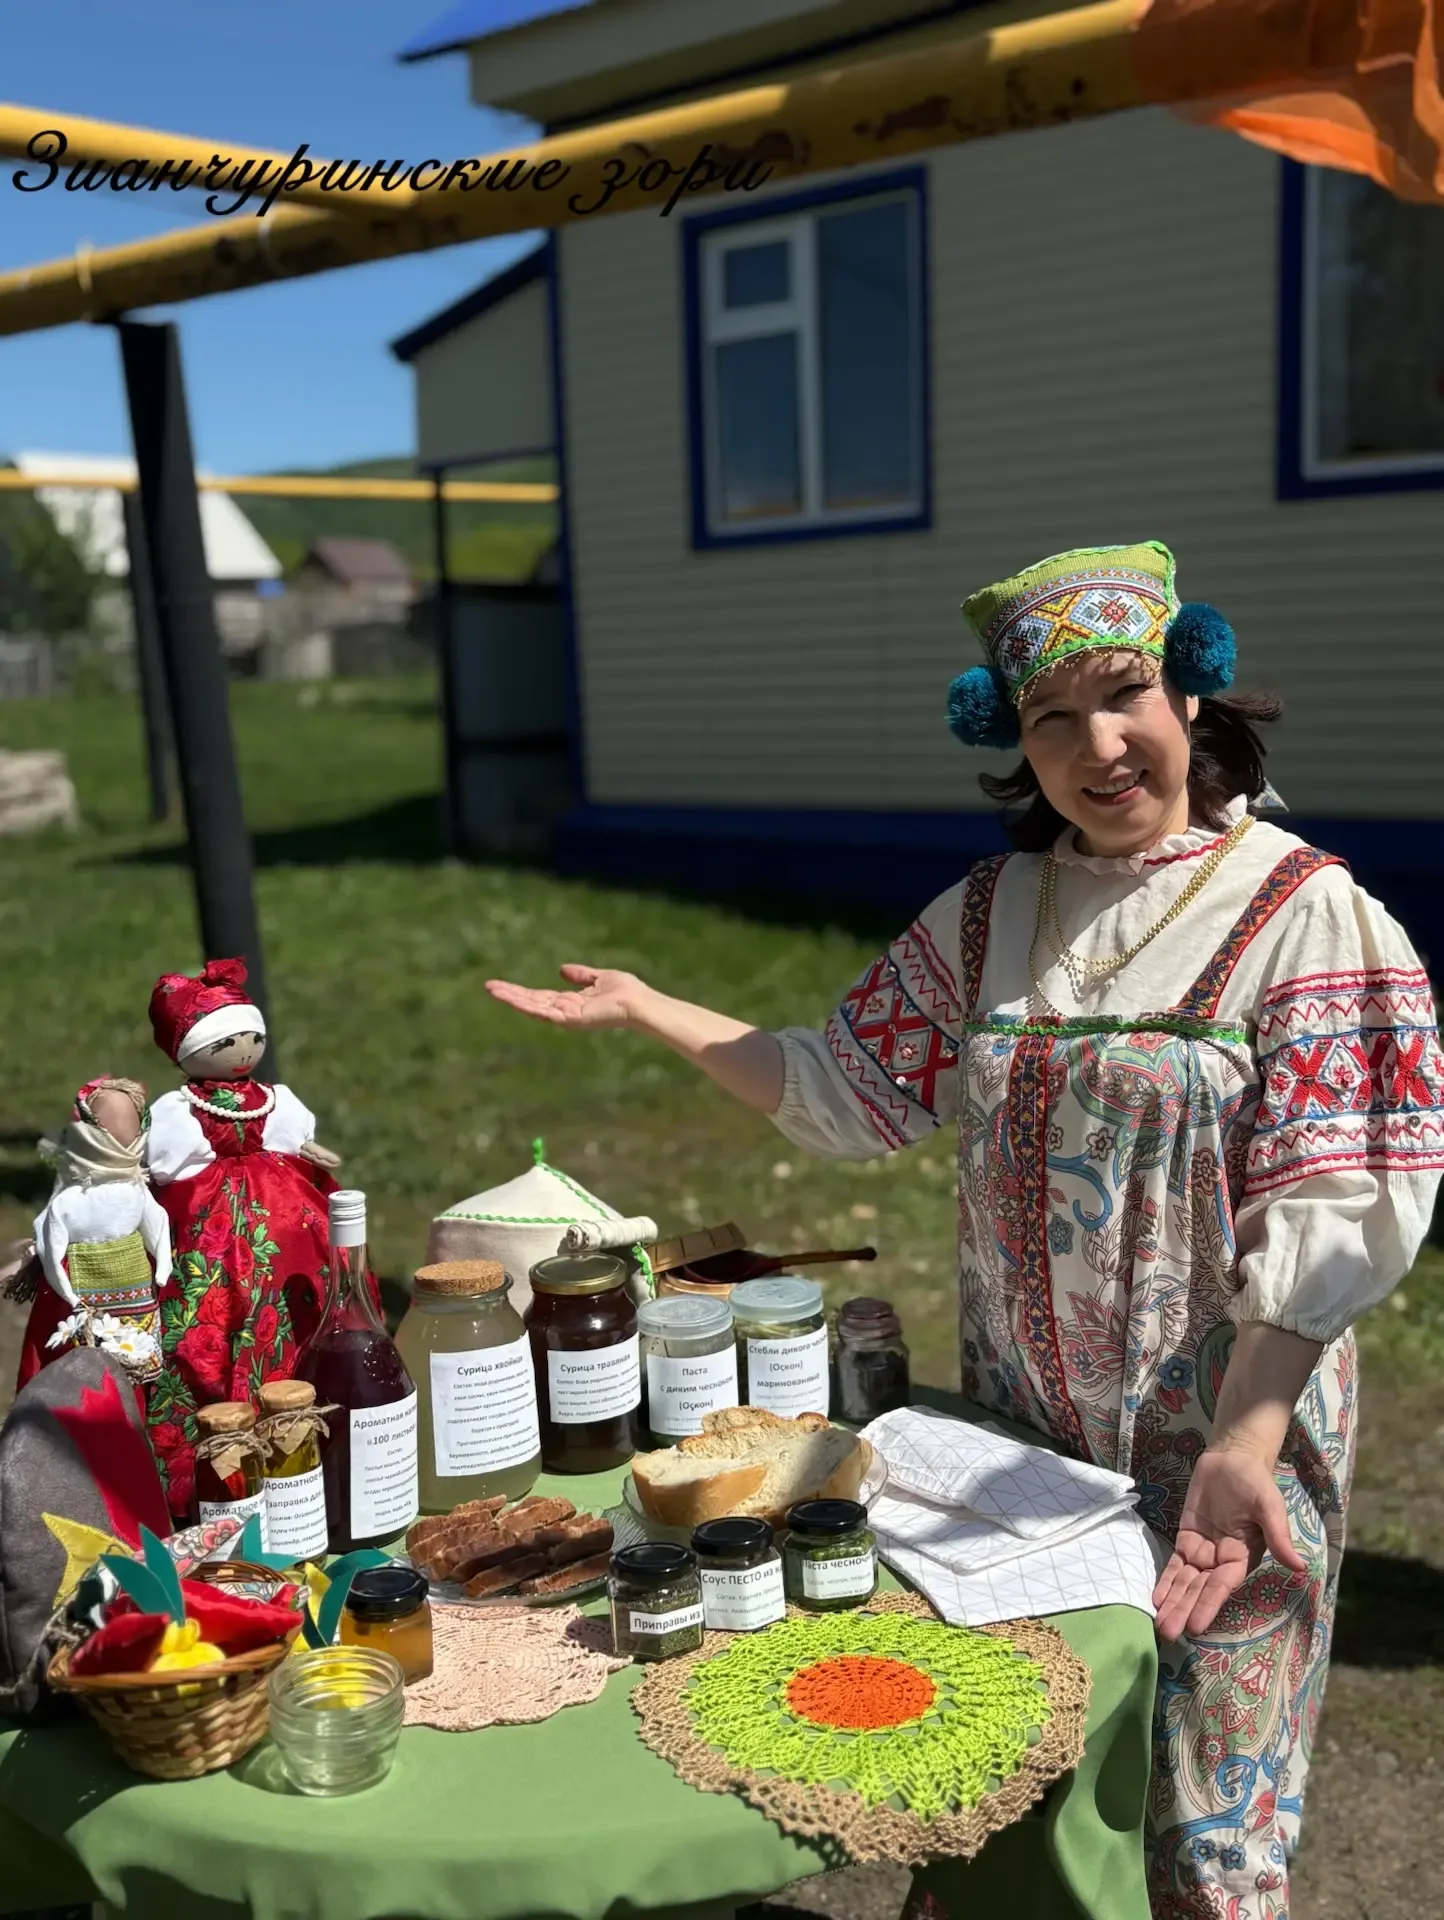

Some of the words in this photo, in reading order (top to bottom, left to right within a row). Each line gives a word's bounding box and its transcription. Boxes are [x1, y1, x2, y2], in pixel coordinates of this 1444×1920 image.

[748, 1345, 779, 1355] Стебли
[781, 1343, 811, 1356] дикого
[457, 1364, 493, 1376] Сурица
[560, 1364, 595, 1374] Сурица
[597, 1354, 631, 1371] травяная
[682, 1367, 708, 1376] Паста
[666, 1386, 697, 1394] диким
[353, 1413, 404, 1430] Ароматная
[265, 1473, 319, 1491] Ароматное
[202, 1501, 259, 1518] Ароматное
[702, 1573, 726, 1586] Соус
[729, 1571, 762, 1585] ПЕСТО
[634, 1615, 688, 1631] Приправы
[689, 1610, 701, 1621] из
